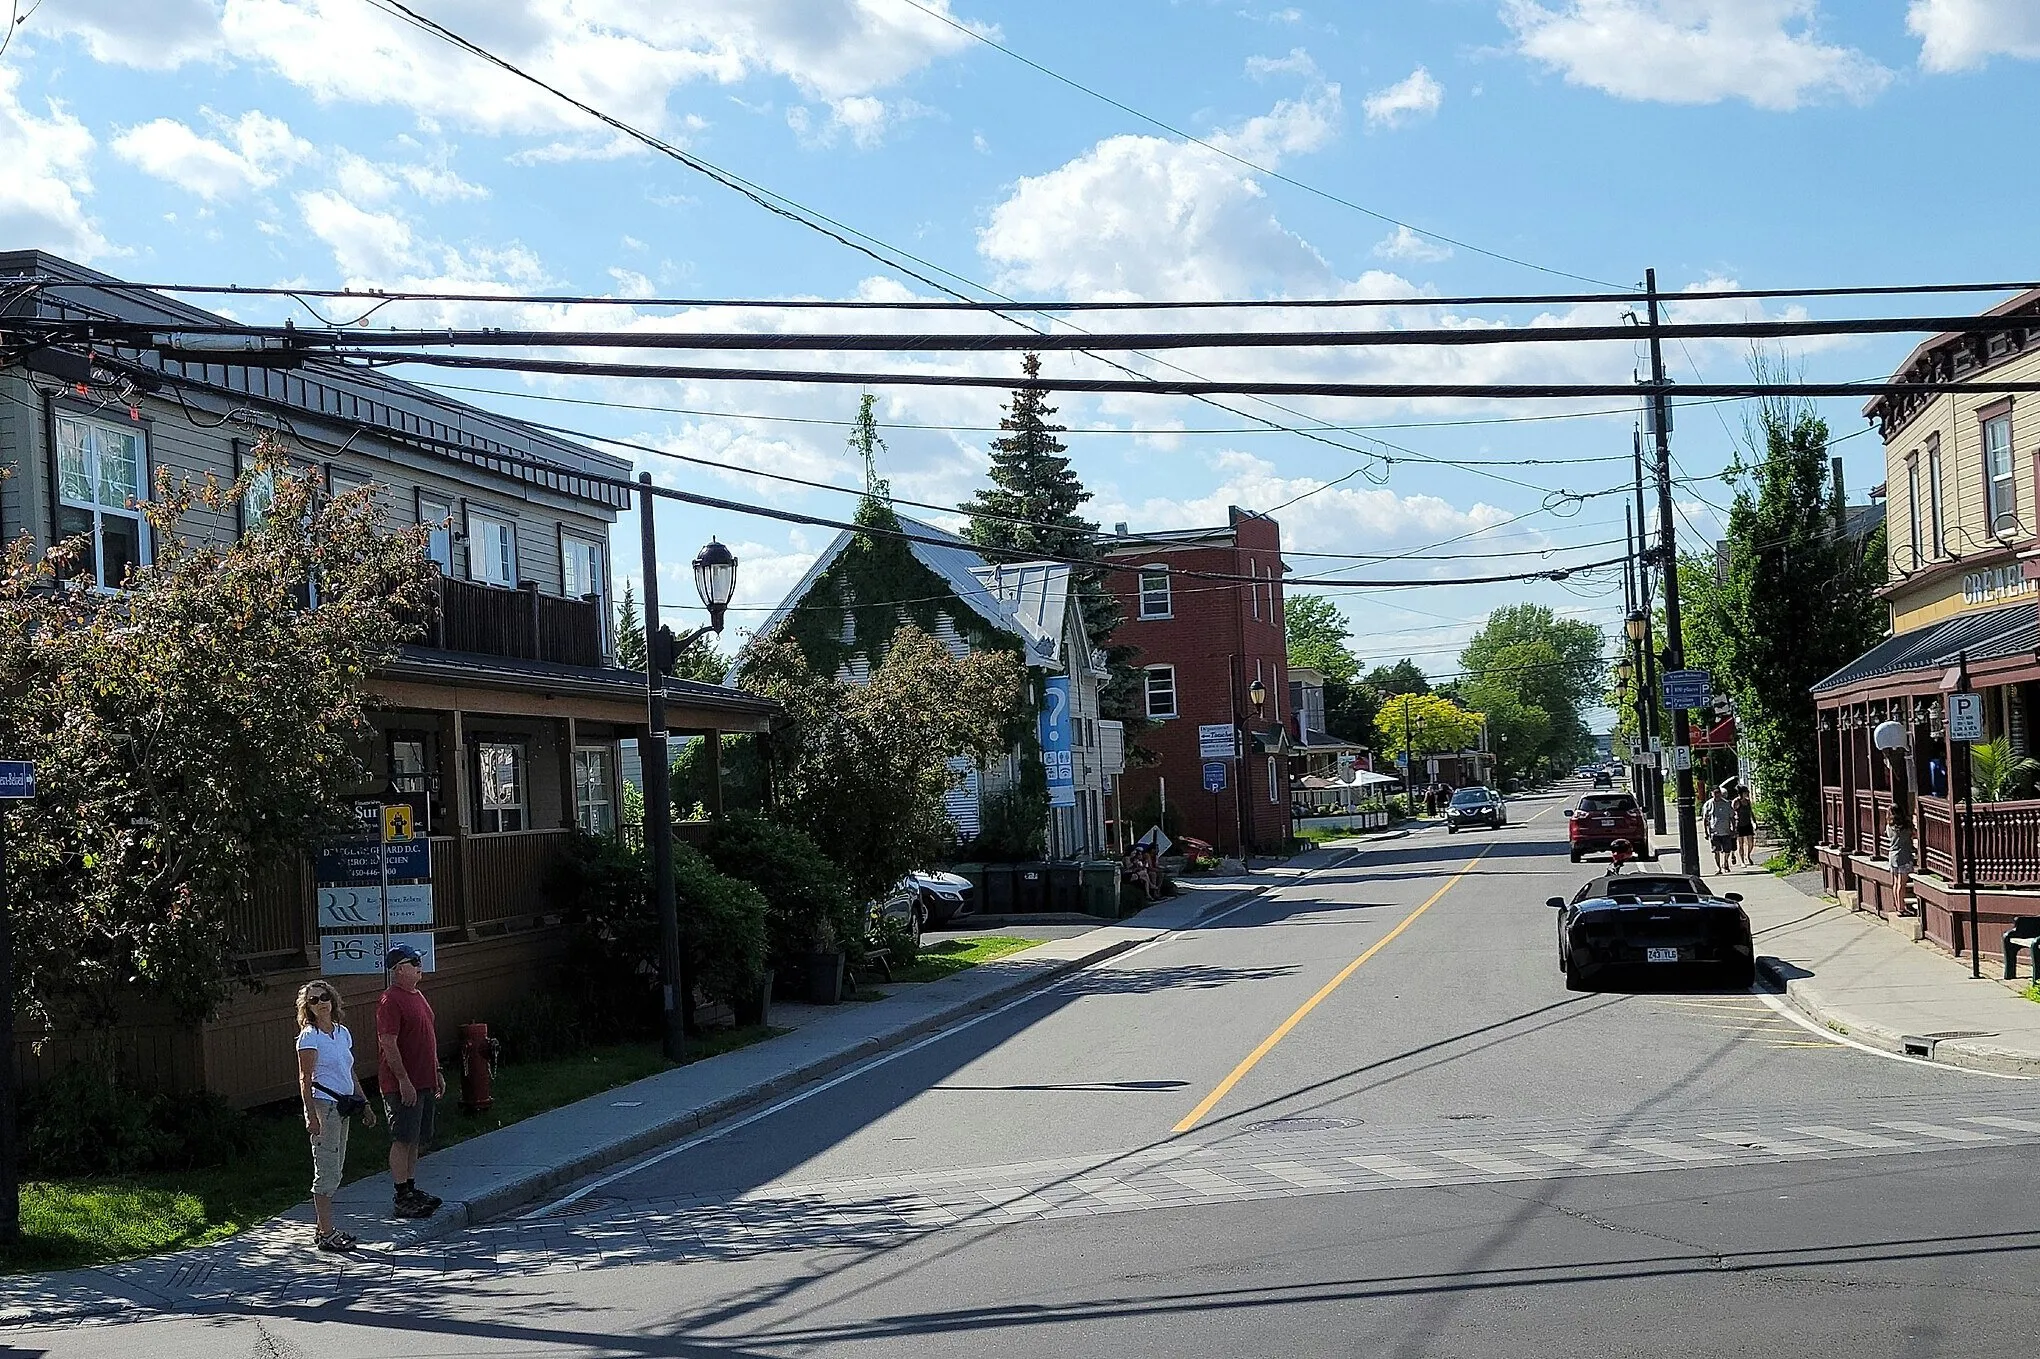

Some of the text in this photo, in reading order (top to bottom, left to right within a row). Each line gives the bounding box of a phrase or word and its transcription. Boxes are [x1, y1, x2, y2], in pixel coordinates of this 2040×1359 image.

[1957, 699, 1972, 716] P
[1678, 749, 1685, 757] P
[331, 940, 364, 961] PG
